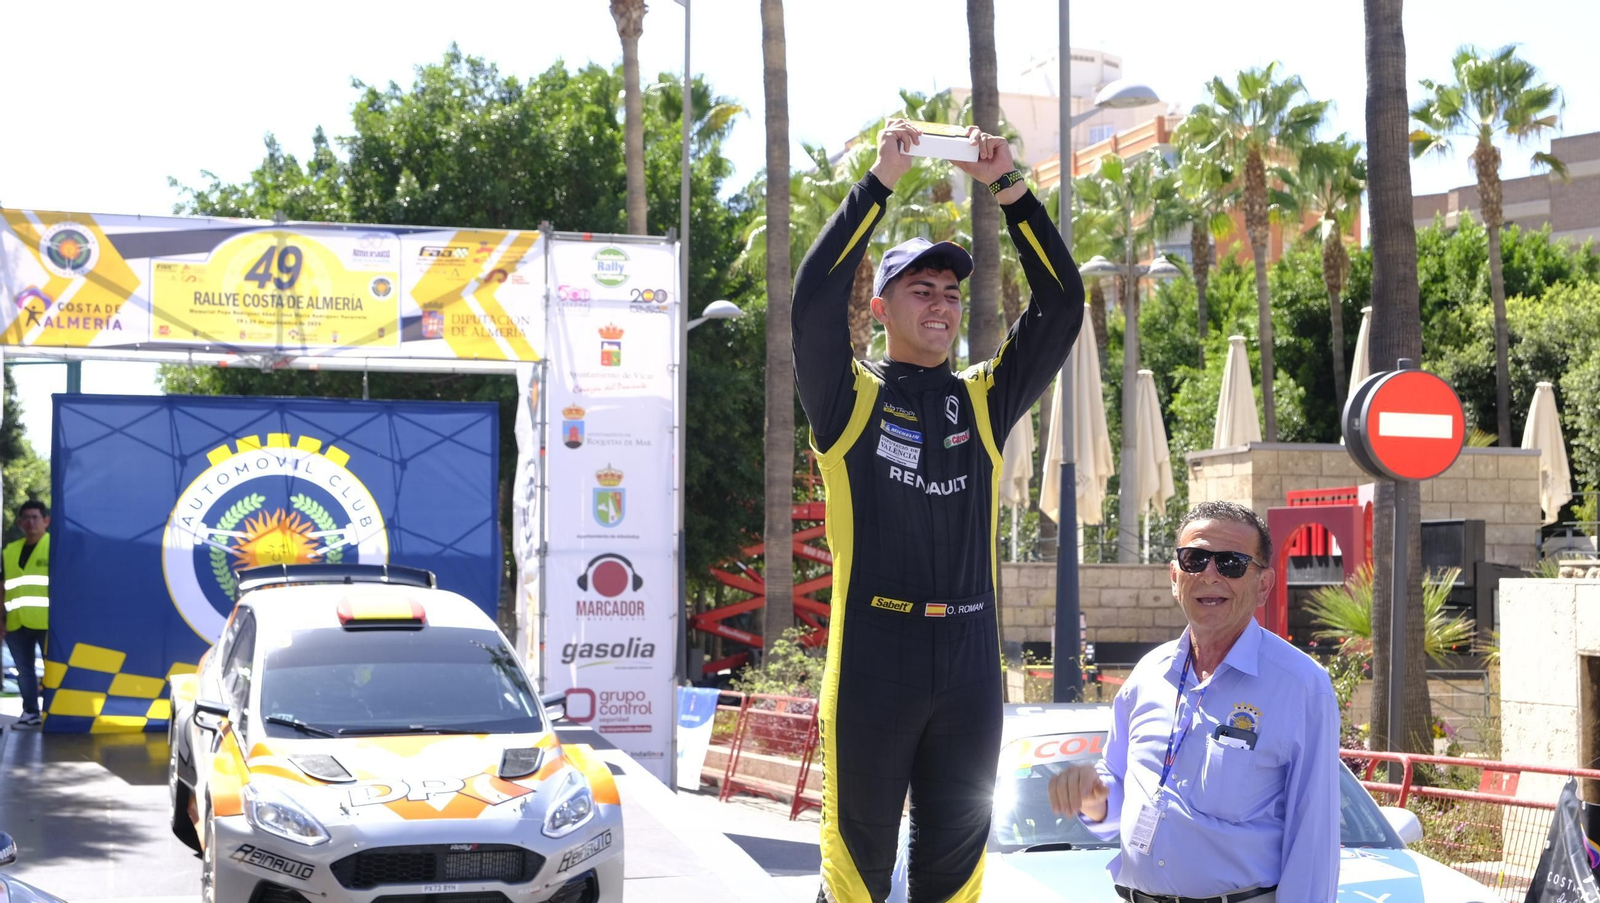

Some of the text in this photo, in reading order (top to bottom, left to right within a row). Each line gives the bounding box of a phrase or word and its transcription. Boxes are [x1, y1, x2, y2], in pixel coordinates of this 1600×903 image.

[244, 245, 303, 290] 49
[597, 261, 625, 276] Rally
[194, 291, 363, 311] RALLYE COSTA DE ALMERÍA
[630, 288, 668, 304] 200
[57, 302, 122, 314] COSTA DE
[44, 315, 122, 331] ALMERÍA
[451, 327, 468, 338] DE
[891, 428, 920, 440] MICHELIN
[587, 438, 622, 447] ROQUETAS
[890, 465, 967, 496] RENAULT
[182, 457, 373, 528] AUTOMOVIL CLUB
[576, 601, 645, 616] MARCADOR
[876, 598, 908, 611] Sabelt
[947, 602, 984, 615] O. ROMAN
[561, 637, 655, 664] gasolia
[599, 690, 645, 705] grupo
[599, 700, 653, 715] control
[599, 716, 629, 724] seguridad
